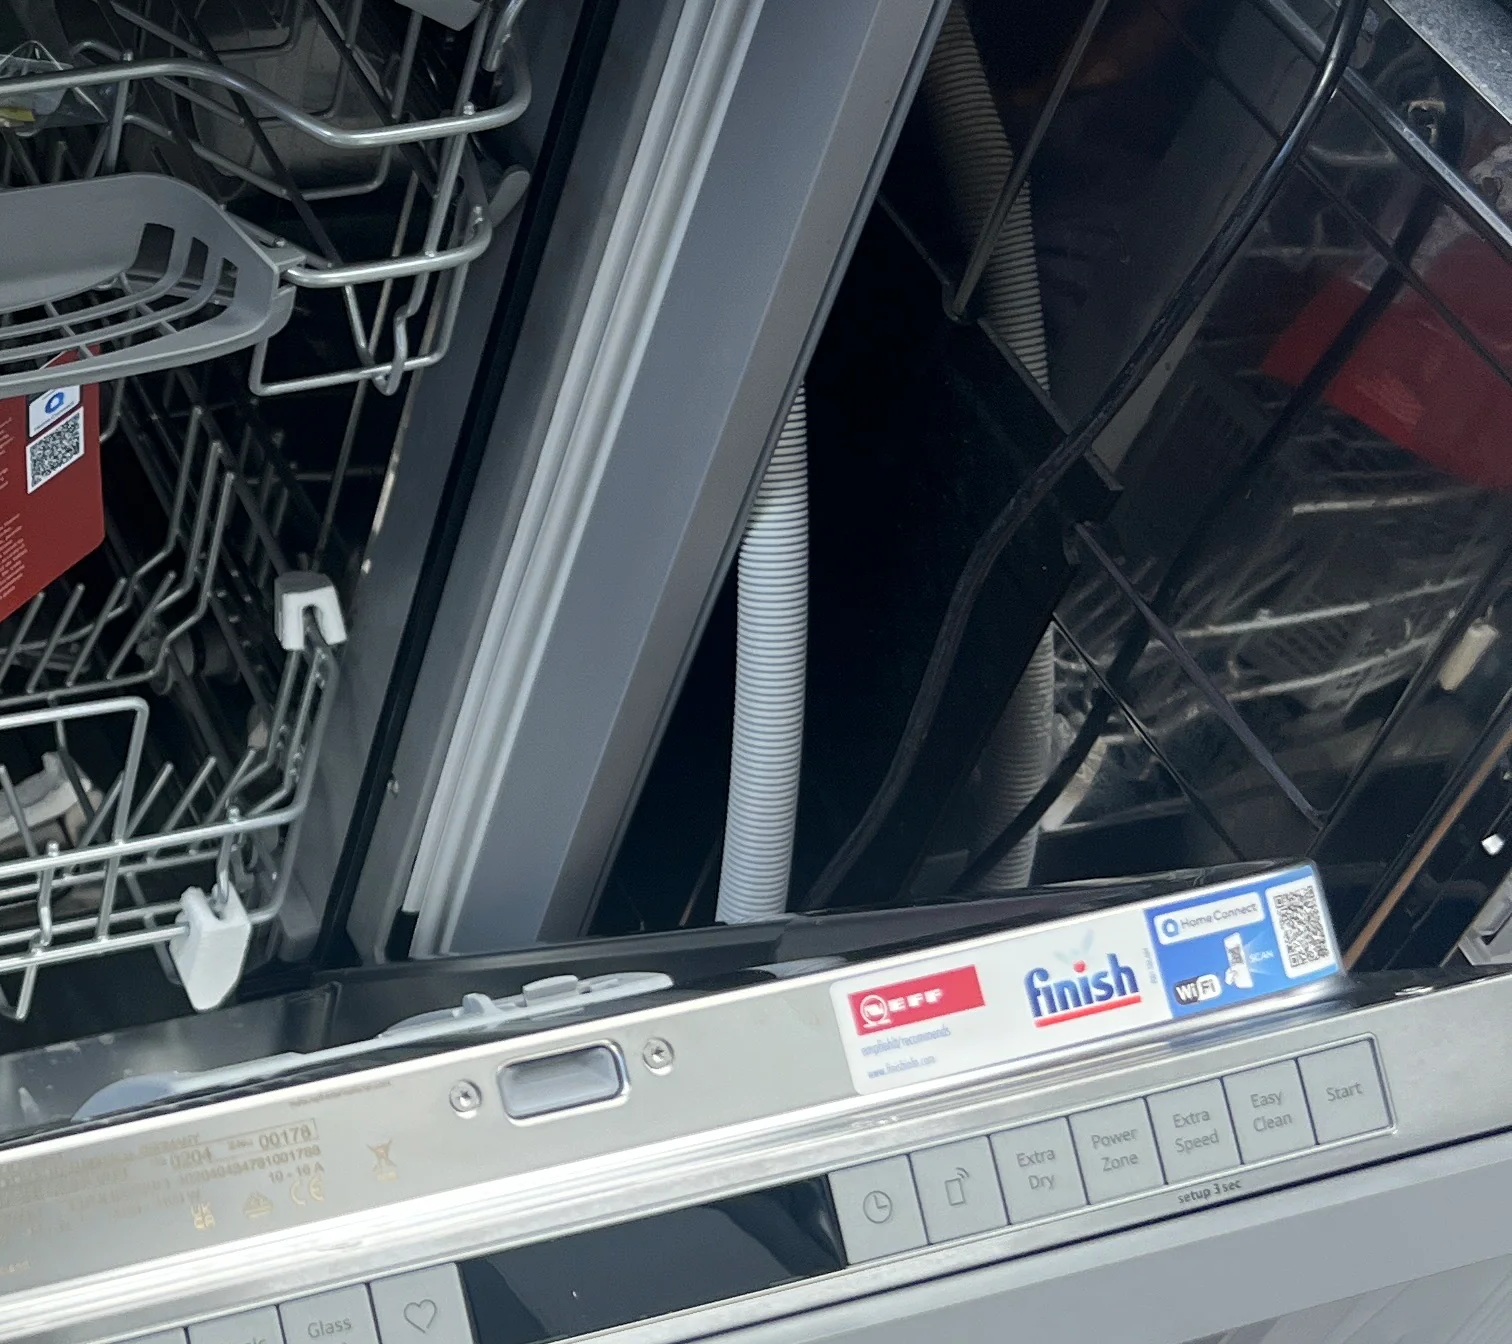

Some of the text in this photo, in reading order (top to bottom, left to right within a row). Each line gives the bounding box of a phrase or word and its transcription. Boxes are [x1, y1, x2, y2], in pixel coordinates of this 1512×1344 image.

[1180, 903, 1258, 929] Home Connect
[1024, 953, 1139, 1018] finish
[860, 988, 944, 1028] NEFF
[1251, 1090, 1282, 1111] Easy
[1326, 1080, 1362, 1103] Start
[1173, 1108, 1210, 1129] Extra
[1253, 1110, 1292, 1132] Clean
[259, 1124, 311, 1150] 00178
[1091, 1127, 1137, 1150] Power
[1175, 1129, 1219, 1155] Speed
[1016, 1147, 1055, 1168] Extra
[1101, 1150, 1138, 1171] Zone
[1029, 1170, 1055, 1193] Dry
[1178, 1184, 1210, 1204] setup
[1222, 1179, 1241, 1193] sec
[307, 1315, 352, 1338] Glass
